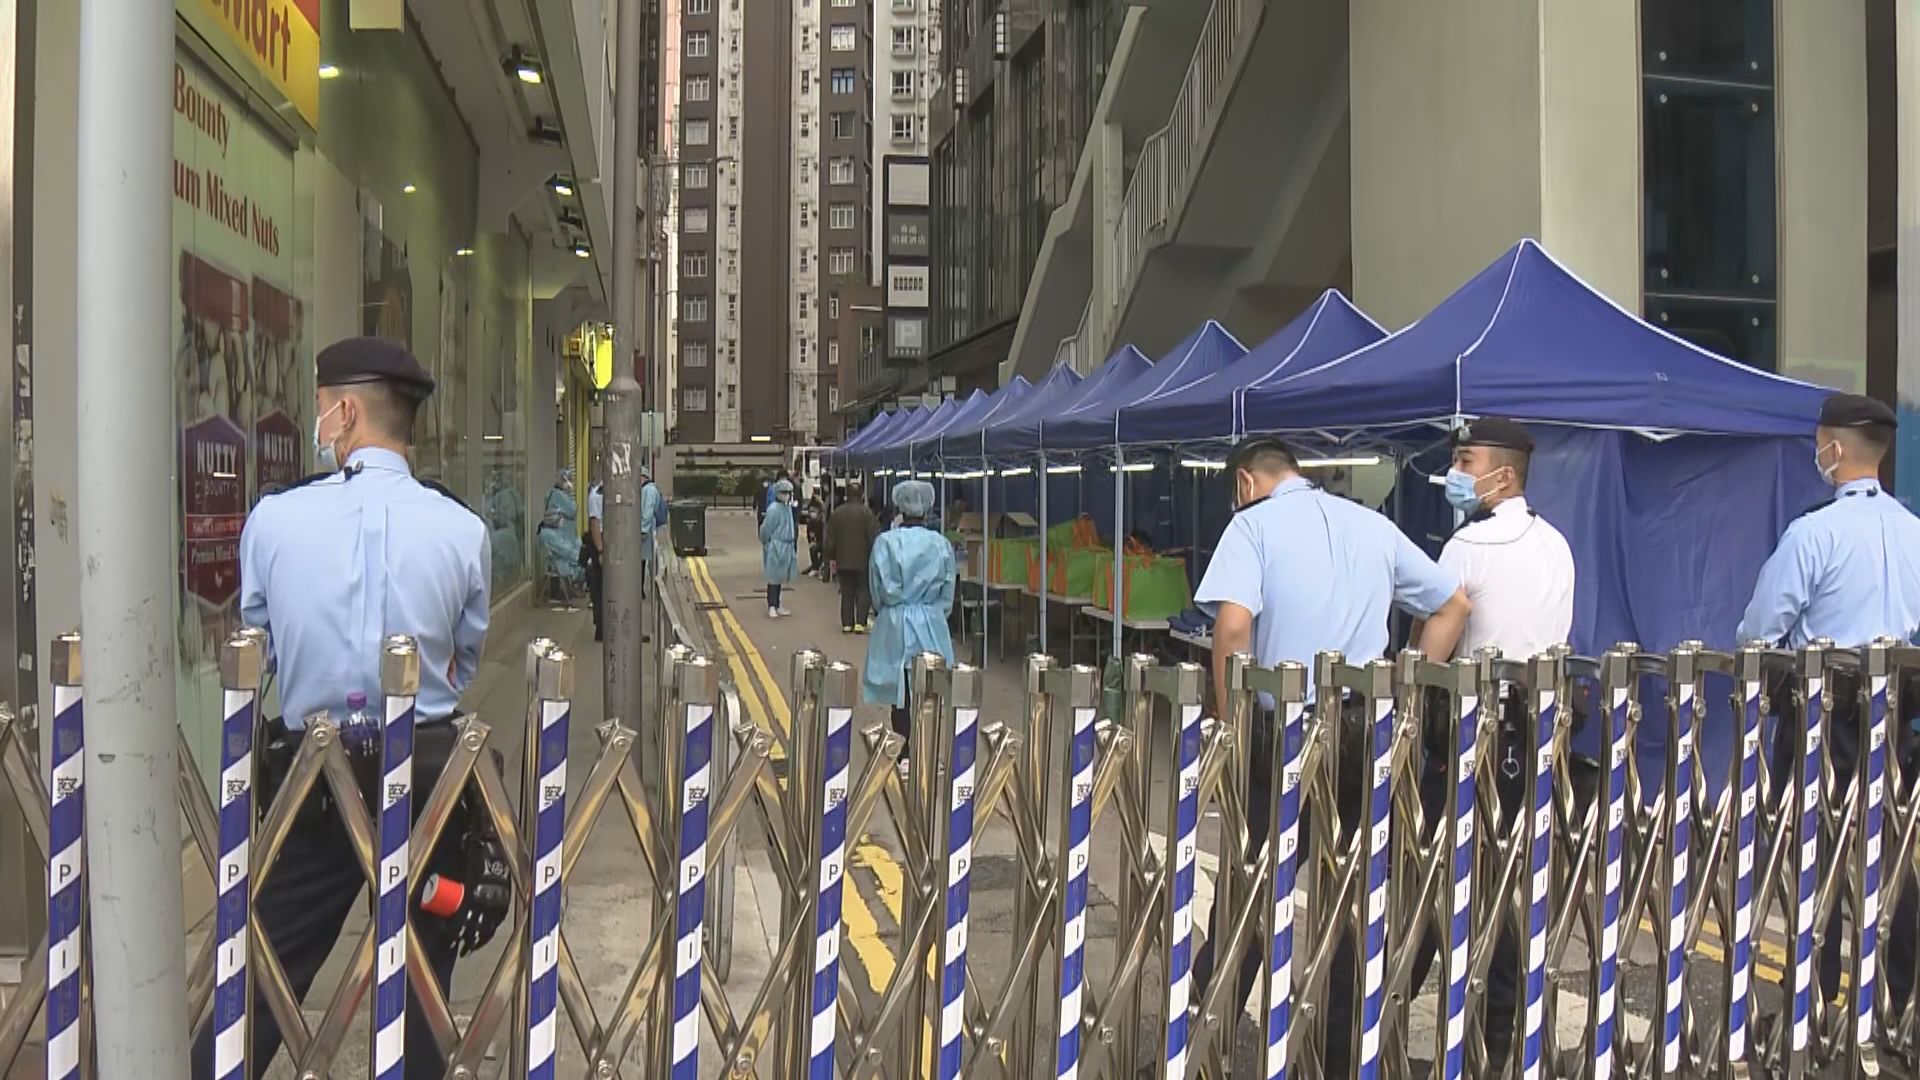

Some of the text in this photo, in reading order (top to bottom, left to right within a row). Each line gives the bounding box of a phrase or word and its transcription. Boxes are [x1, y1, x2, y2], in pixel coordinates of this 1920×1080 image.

[174, 61, 230, 159] Bounty
[207, 168, 248, 238] Mixed
[252, 202, 279, 257] Nuts
[197, 440, 237, 474] NUTTY
[264, 432, 294, 463] NUTTY
[204, 480, 232, 497] BOUNTY
